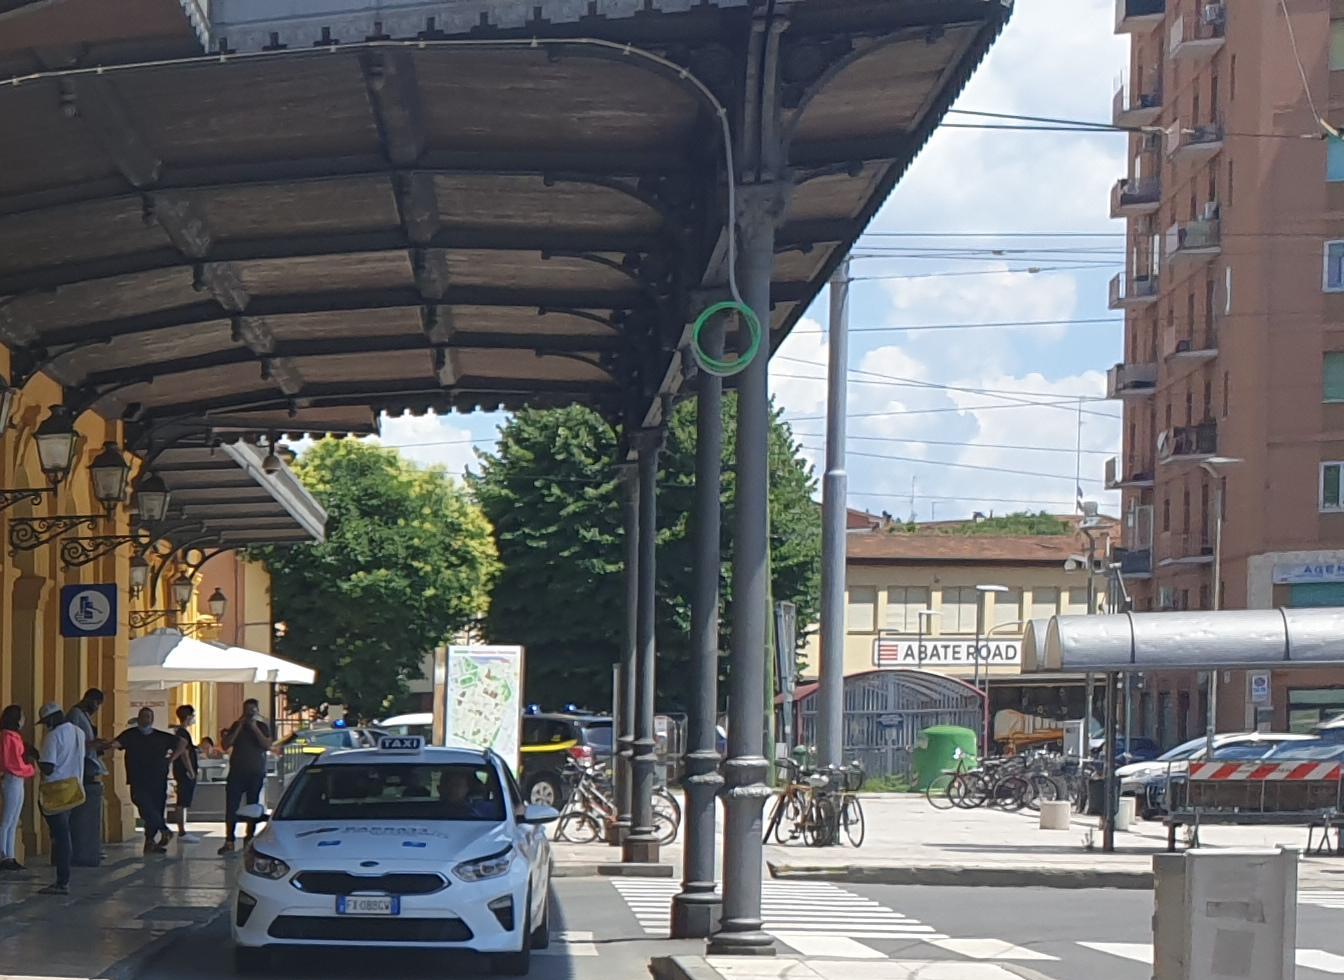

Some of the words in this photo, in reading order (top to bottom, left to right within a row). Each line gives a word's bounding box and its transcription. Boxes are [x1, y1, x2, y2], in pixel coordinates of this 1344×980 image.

[903, 644, 962, 661] ABATE
[966, 644, 1017, 661] ROAD
[384, 739, 418, 748] TAXI
